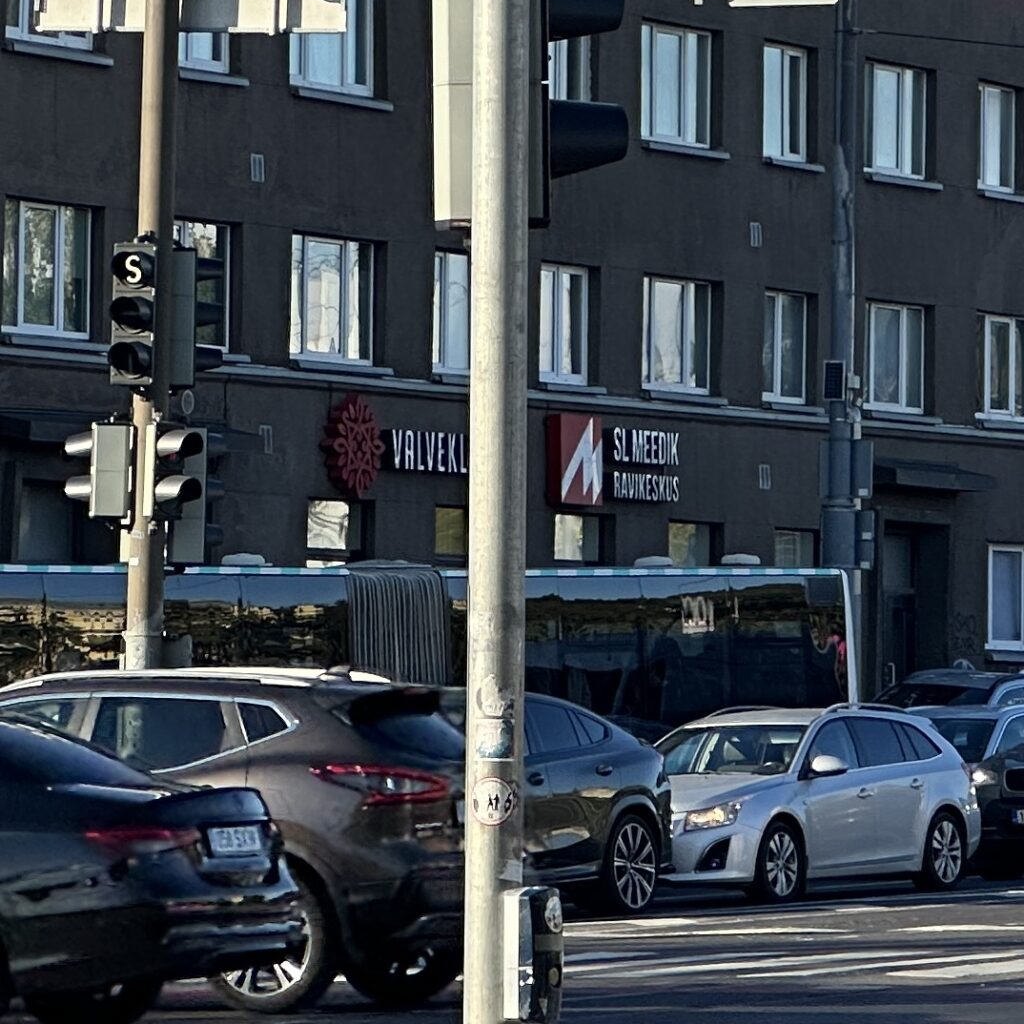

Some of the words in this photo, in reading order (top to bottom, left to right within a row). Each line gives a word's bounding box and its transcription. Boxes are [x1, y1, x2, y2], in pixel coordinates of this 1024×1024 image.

[125, 254, 142, 283] S
[392, 429, 467, 473] VALVEKL
[614, 427, 629, 462] SL
[632, 429, 679, 465] MEEDIK
[614, 471, 679, 502] RAVIKESKUS
